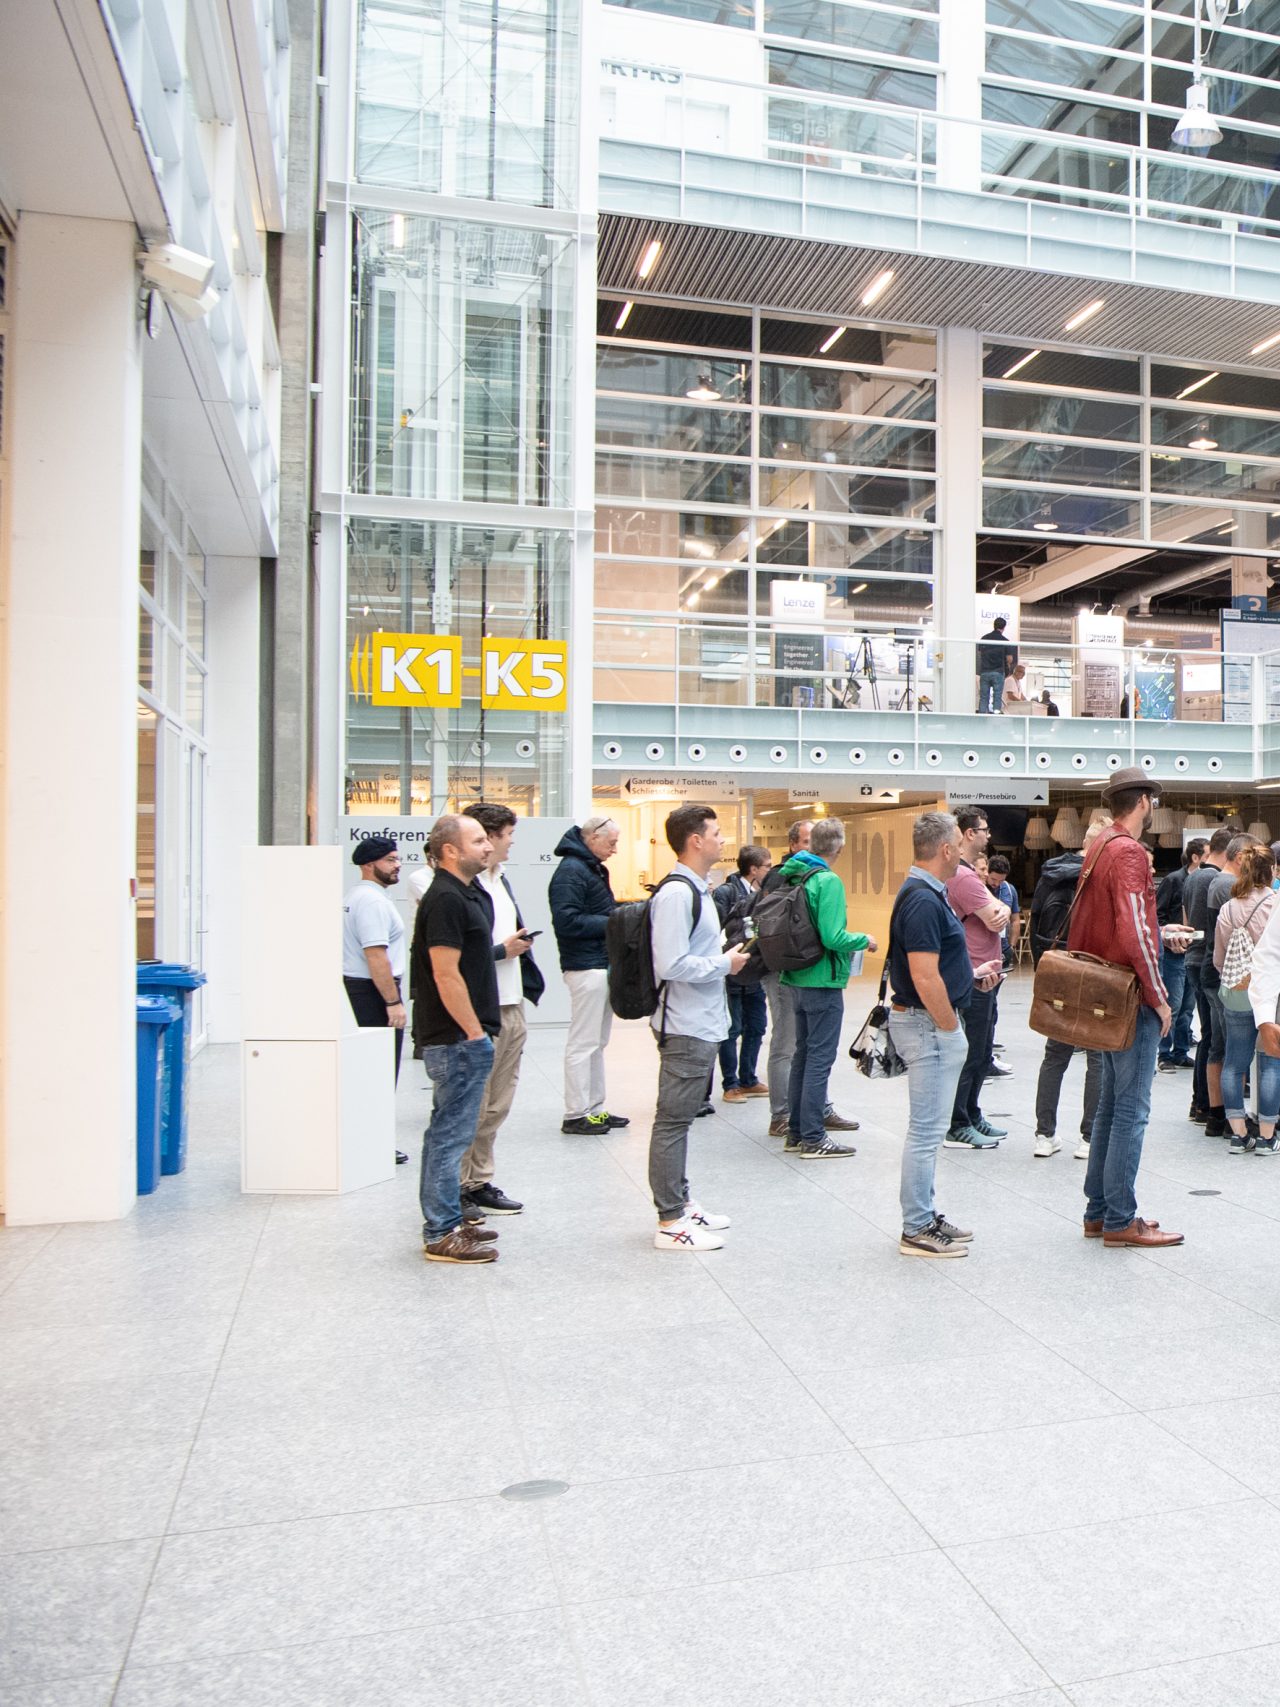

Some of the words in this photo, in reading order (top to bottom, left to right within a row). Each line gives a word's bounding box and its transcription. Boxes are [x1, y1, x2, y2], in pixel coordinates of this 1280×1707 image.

[783, 597, 816, 608] Lenze
[981, 609, 1011, 620] Lenze
[632, 777, 674, 786] Garderobe
[682, 777, 718, 786] Toiletten
[792, 789, 820, 798] Sanität
[950, 792, 1016, 801] Messe-/Pressebüro
[407, 853, 419, 861] K2
[540, 854, 551, 862] K5
